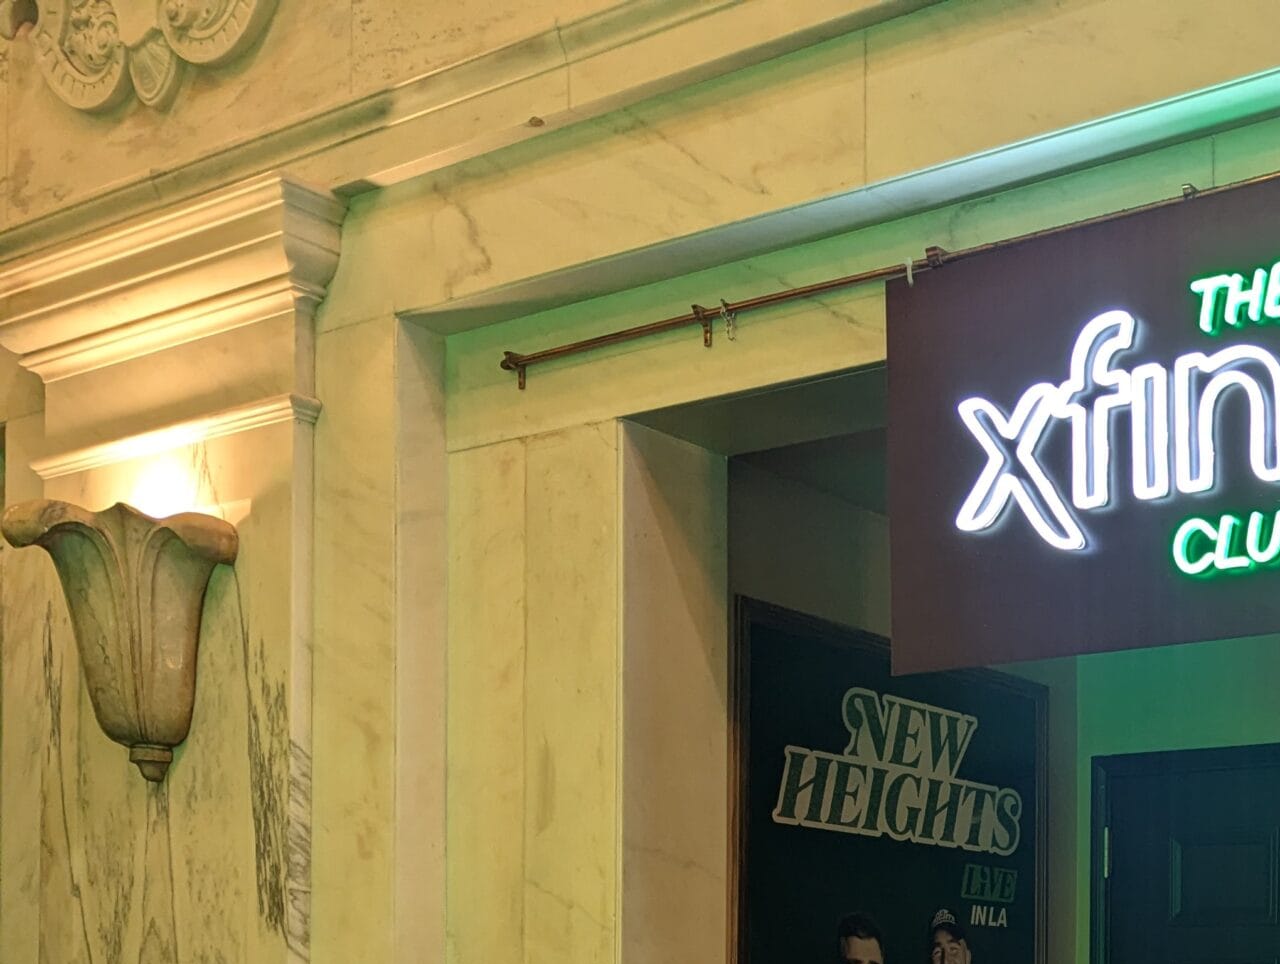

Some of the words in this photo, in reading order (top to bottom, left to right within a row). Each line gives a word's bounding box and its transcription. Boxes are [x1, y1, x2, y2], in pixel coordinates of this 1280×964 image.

[842, 687, 977, 778] NEW
[772, 745, 1022, 856] HEIGHTS
[961, 864, 1017, 902] LIVE
[970, 904, 987, 926] IN
[988, 906, 1008, 928] LA
